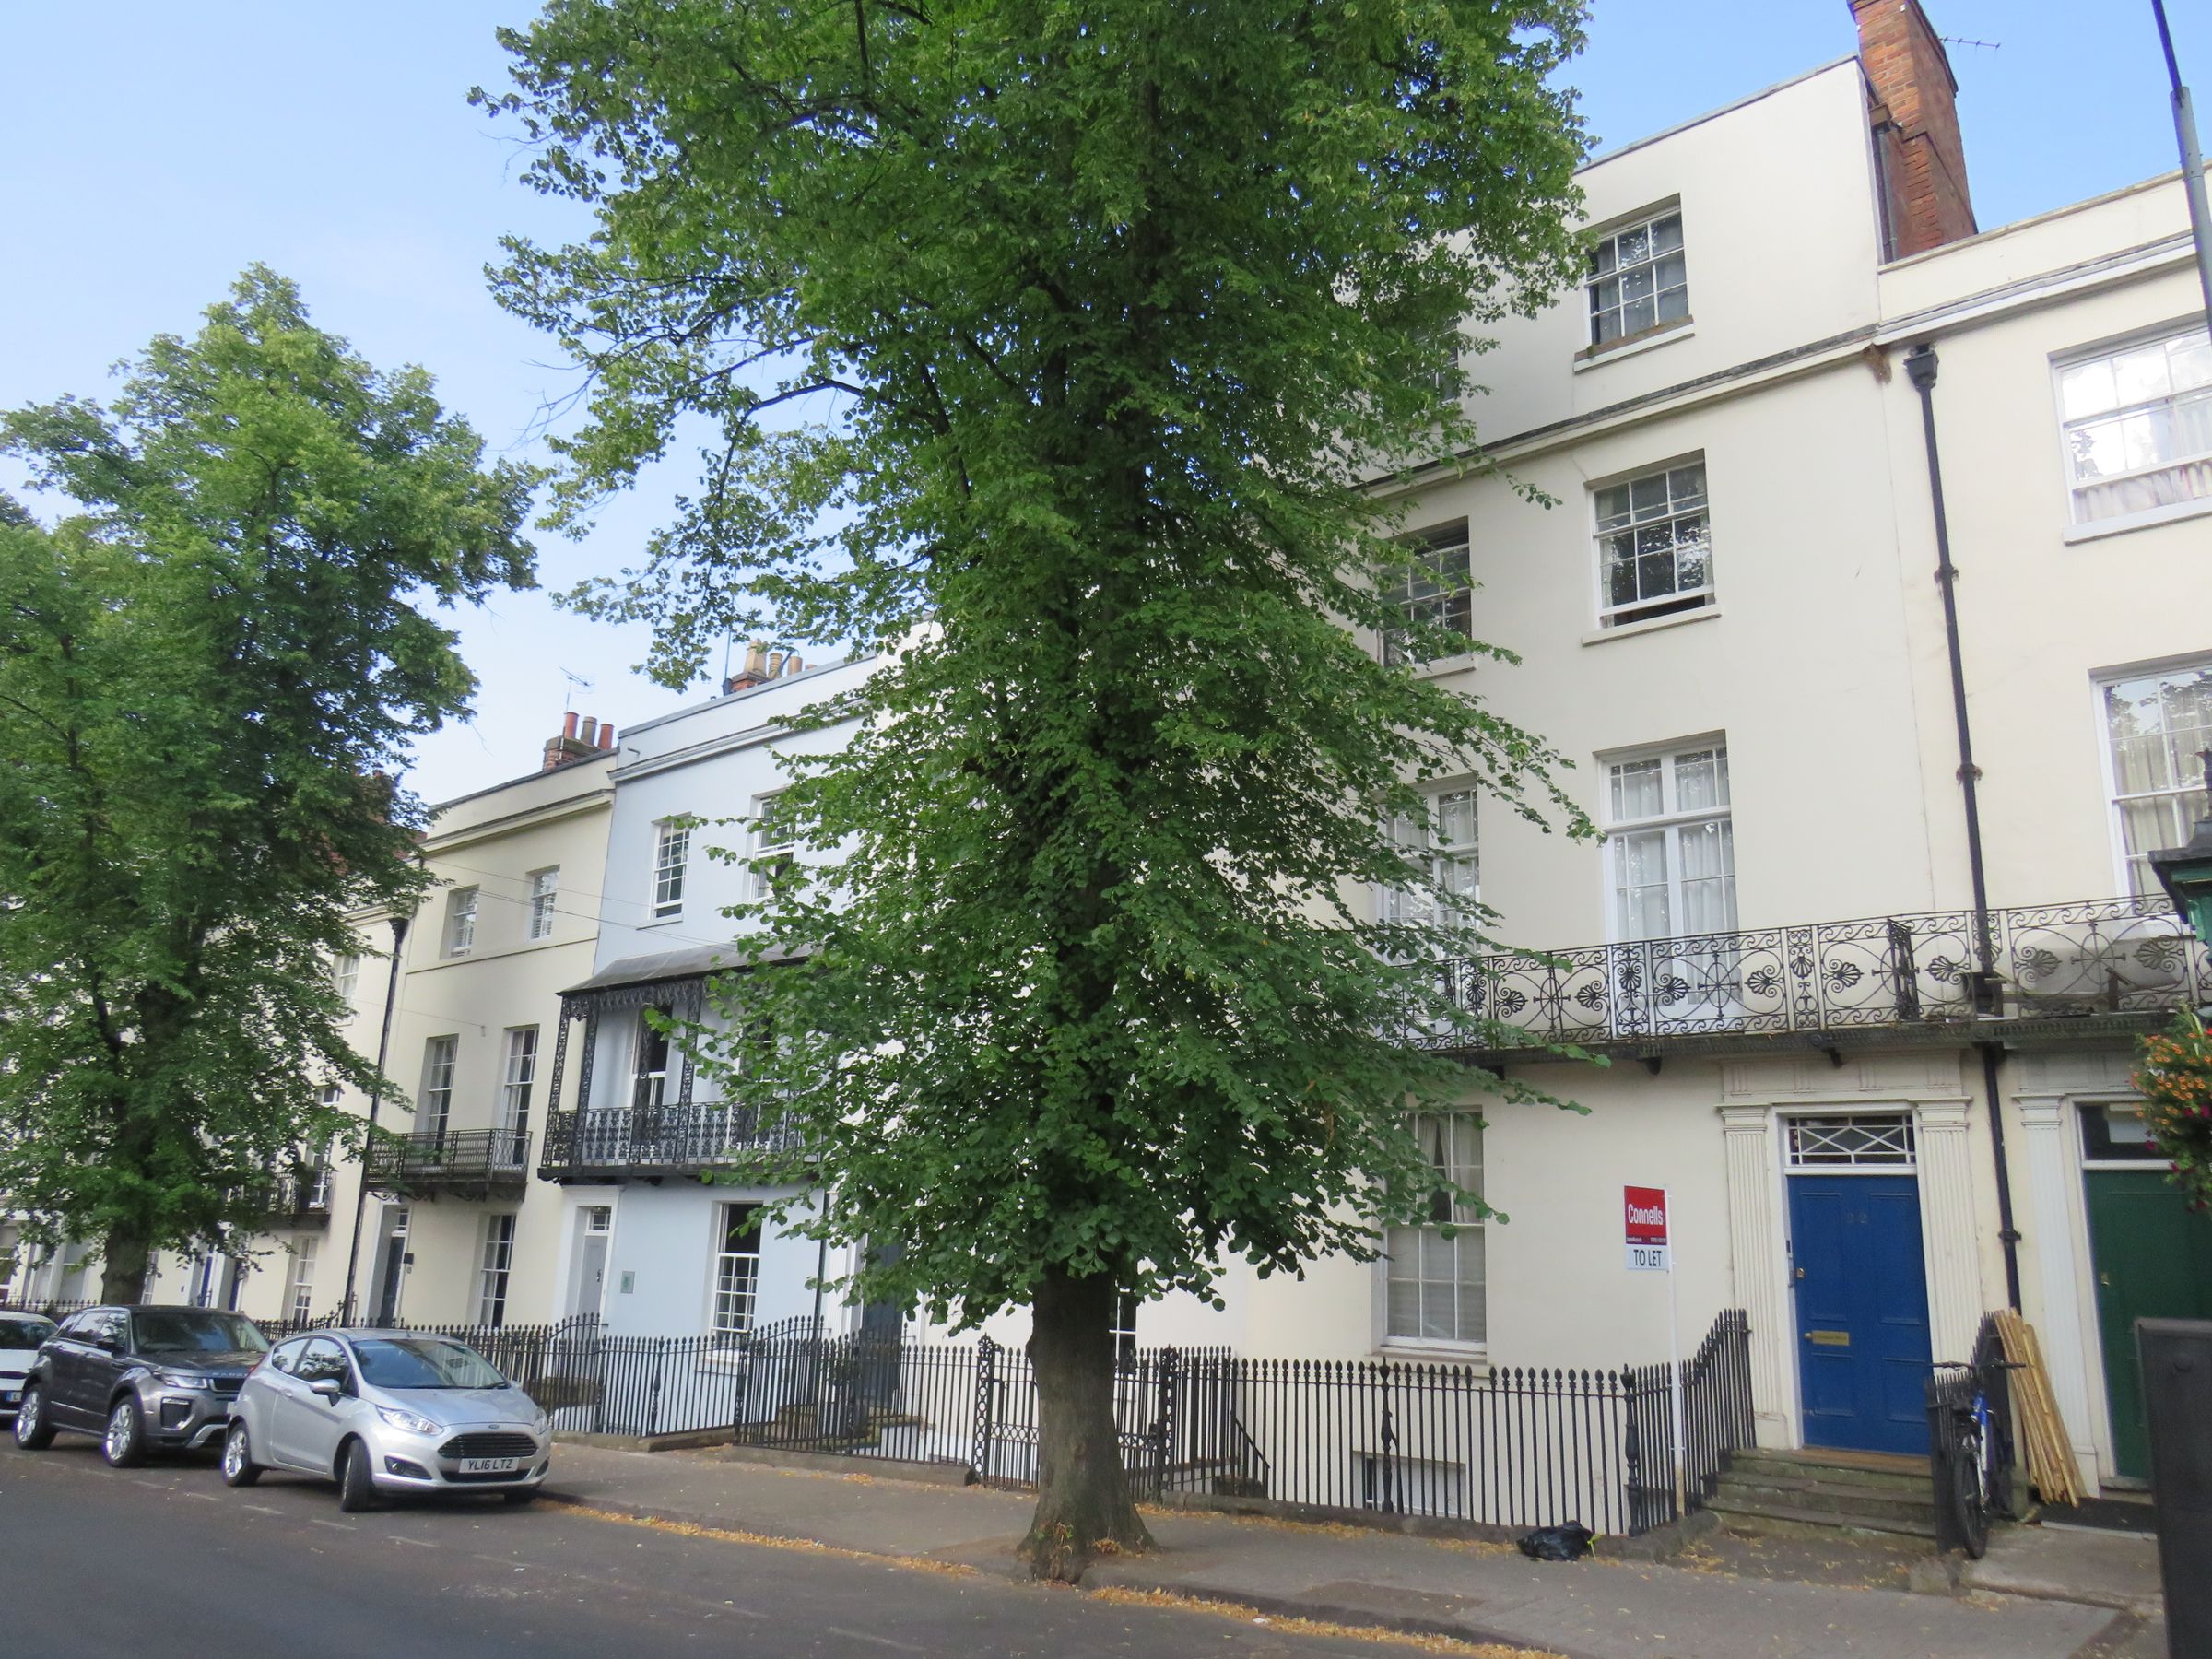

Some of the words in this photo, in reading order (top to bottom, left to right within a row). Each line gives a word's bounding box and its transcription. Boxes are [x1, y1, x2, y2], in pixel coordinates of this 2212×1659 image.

[1628, 1203, 1664, 1226] Connells
[1633, 1249, 1646, 1266] TO
[1648, 1250, 1662, 1267] LET
[468, 1460, 491, 1471] YL16
[493, 1459, 513, 1470] LTZ
